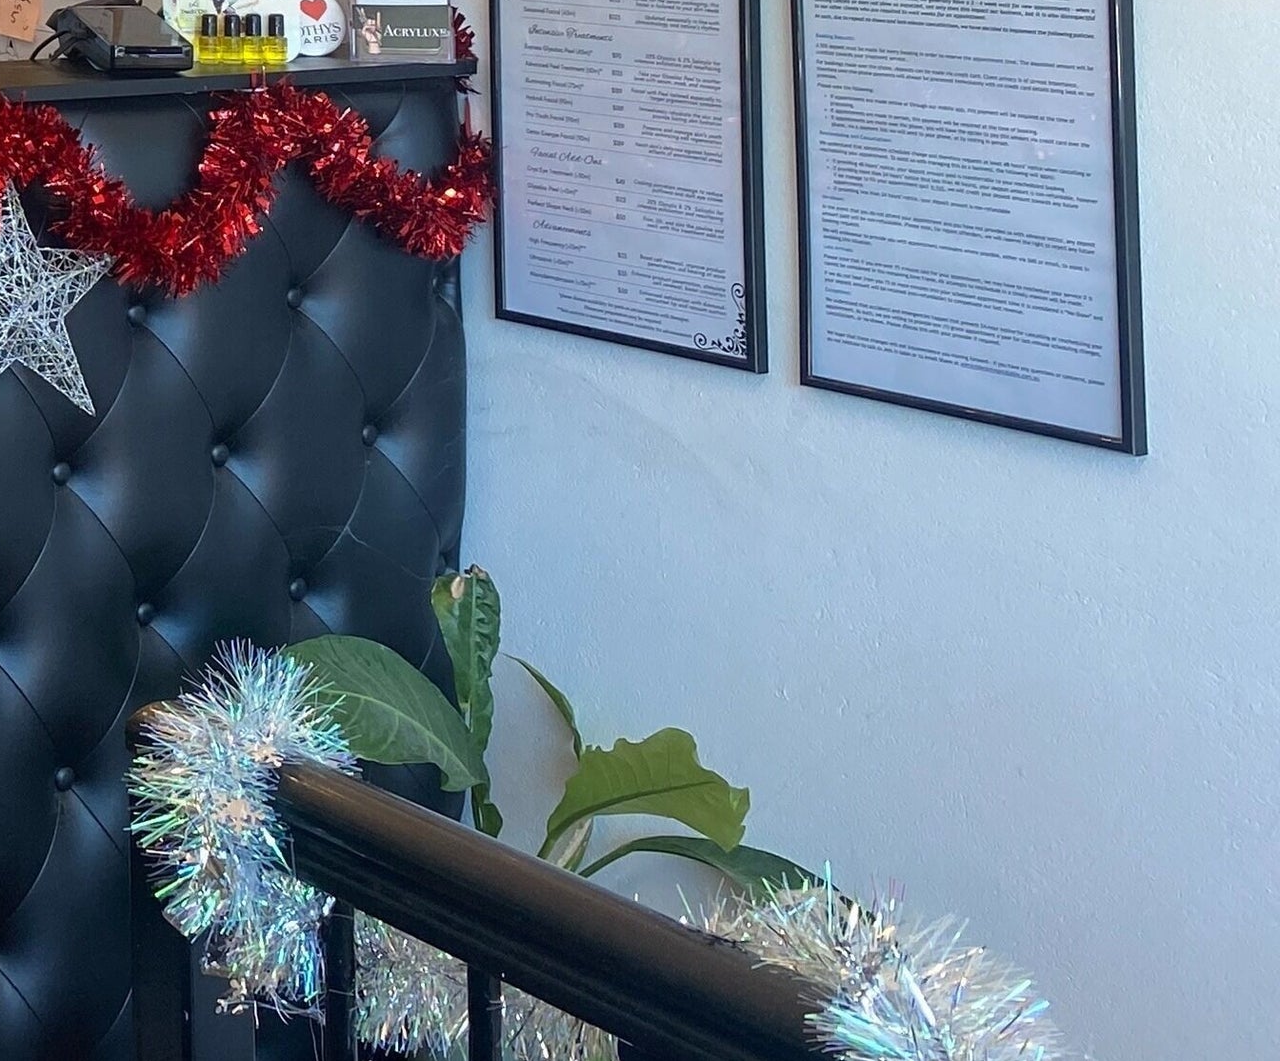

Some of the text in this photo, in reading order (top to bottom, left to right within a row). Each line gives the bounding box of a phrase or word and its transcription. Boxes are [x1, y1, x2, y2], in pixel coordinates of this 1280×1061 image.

[14, 4, 22, 12] in
[10, 11, 19, 24] 5
[300, 21, 341, 37] THYS
[303, 33, 339, 45] ARIS
